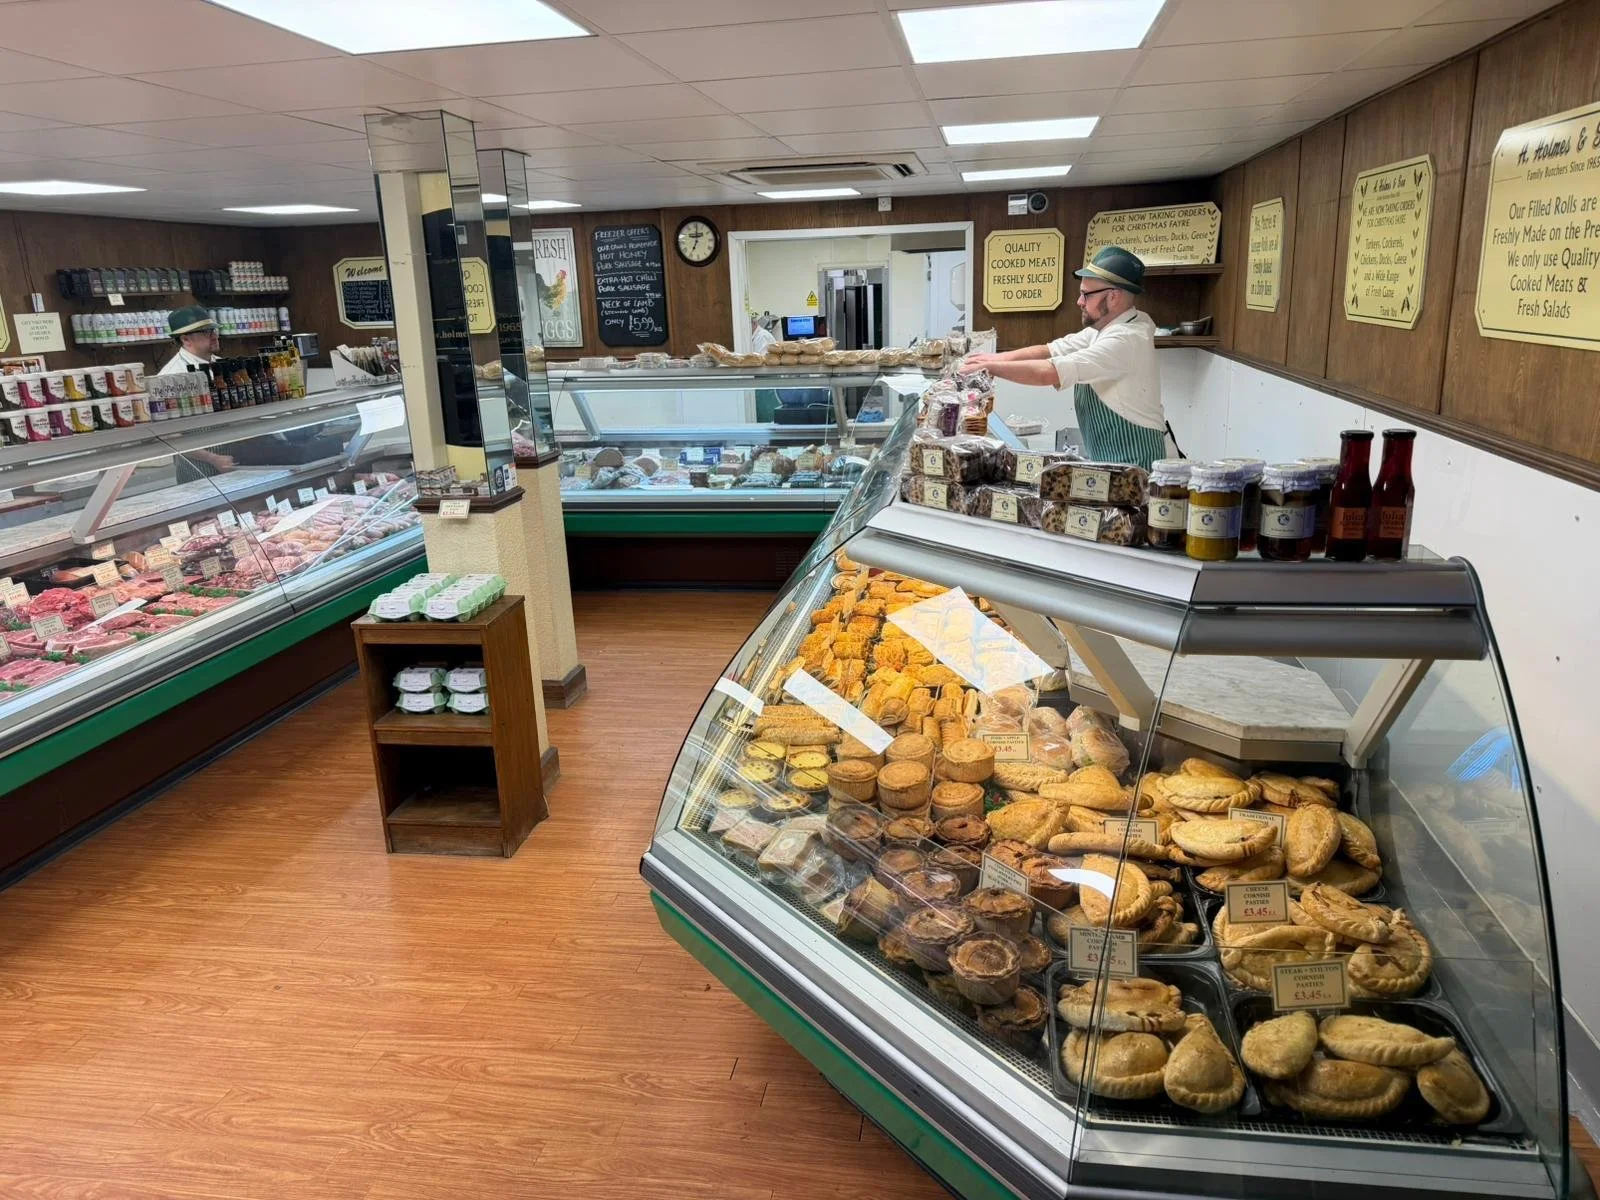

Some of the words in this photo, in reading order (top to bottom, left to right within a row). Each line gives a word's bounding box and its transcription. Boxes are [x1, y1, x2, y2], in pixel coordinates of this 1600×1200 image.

[1532, 135, 1571, 162] Holmes
[1527, 170, 1542, 180] Family
[1545, 165, 1567, 177] Butchers
[1570, 161, 1584, 173] Since
[1509, 203, 1525, 220] Our
[1528, 198, 1552, 218] Filled
[1554, 195, 1577, 214] Rolls
[1580, 197, 1597, 212] are
[1149, 212, 1176, 220] TAKING
[1178, 208, 1206, 217] ORDERS
[1127, 222, 1167, 231] CHRISTMAS
[1169, 219, 1190, 227] FAYRE
[595, 230, 625, 241] FREEZER
[1144, 234, 1169, 243] Chickens,
[1171, 233, 1189, 241] Ducks,
[1191, 231, 1208, 240] Geese
[1492, 228, 1520, 246] Freshly
[1522, 224, 1546, 242] Made
[1549, 227, 1561, 241] on
[1565, 221, 1580, 239] the
[533, 238, 567, 260] RESH
[1004, 242, 1041, 254] QUALITY
[1160, 245, 1175, 253] Fresh
[1177, 244, 1194, 252] Game
[619, 250, 647, 259] HONEY
[1395, 252, 1407, 264] Geese
[1507, 250, 1519, 267] We
[1522, 250, 1540, 270] only
[1543, 254, 1557, 267] use
[1562, 248, 1600, 269] Quality
[615, 260, 642, 268] SAUSAGE
[991, 258, 1026, 269] COOKED
[1028, 257, 1056, 268] MEATS
[345, 265, 384, 278] Welcome
[1376, 270, 1385, 280] Wide
[1387, 270, 1399, 283] Range
[993, 274, 1024, 284] FRESHLY
[1027, 273, 1053, 283] SLICED
[1510, 274, 1542, 292] Cooked
[1545, 274, 1573, 292] Meats
[1577, 277, 1588, 292] &
[1002, 291, 1013, 300] TO
[1016, 289, 1042, 299] ORDER
[1370, 285, 1381, 297] Fresh
[1383, 286, 1394, 297] Game
[602, 300, 620, 308] NECK
[634, 299, 654, 307] LAMB
[1517, 298, 1540, 317] Fresh
[1542, 300, 1571, 318] Salads
[605, 319, 624, 327] ONLY
[545, 320, 574, 339] GGS
[1244, 908, 1267, 916] £3.45
[1294, 990, 1321, 1000] £3.45
